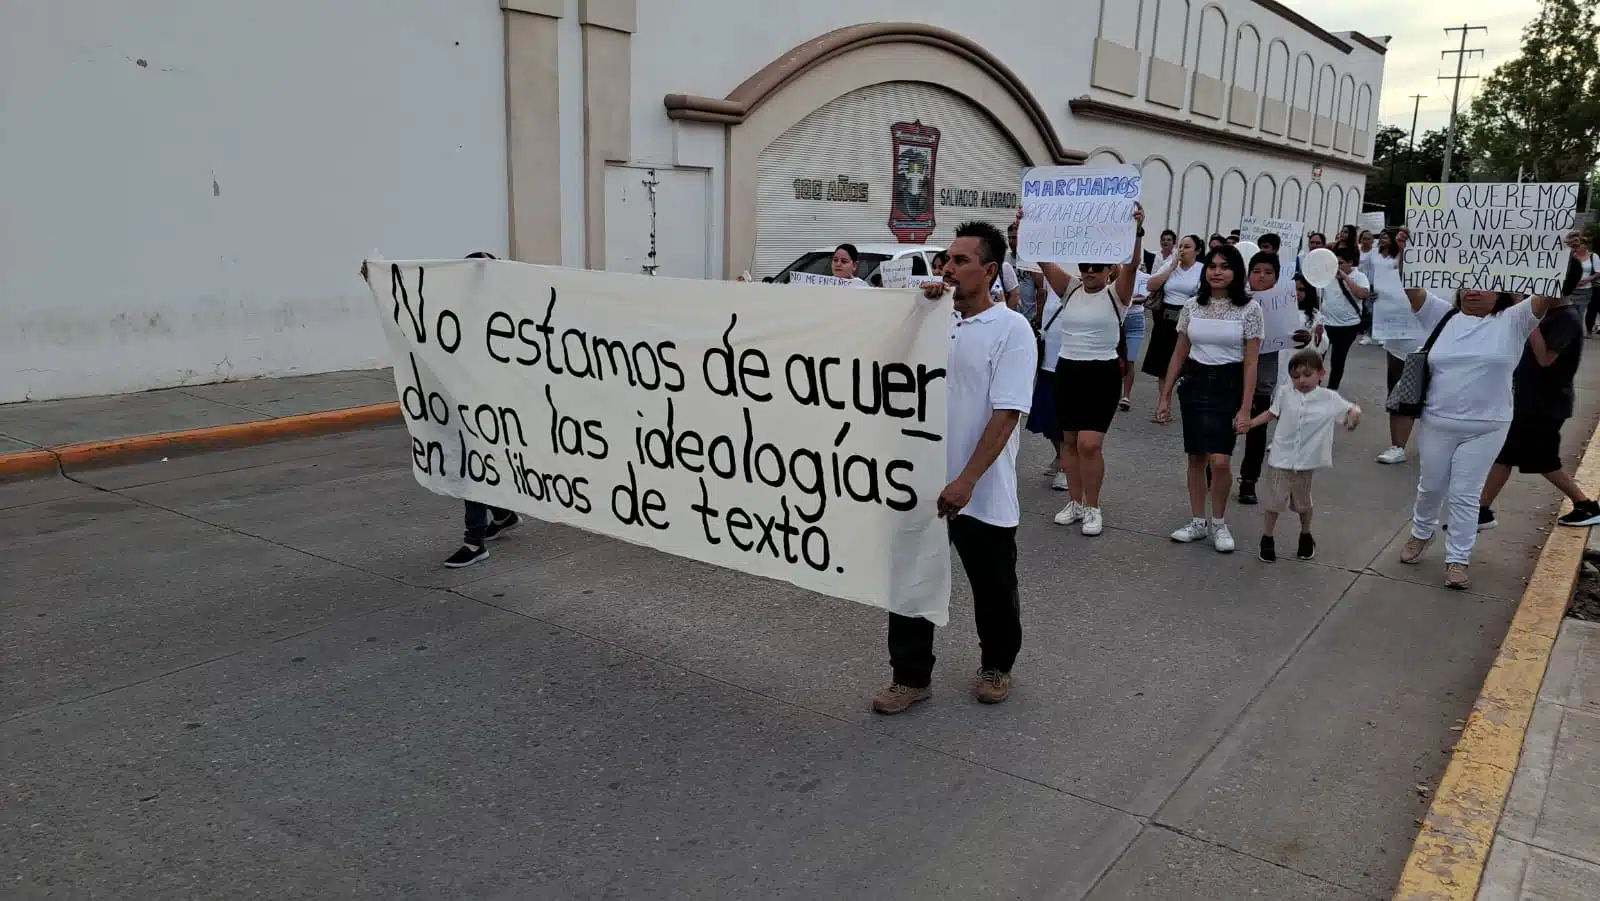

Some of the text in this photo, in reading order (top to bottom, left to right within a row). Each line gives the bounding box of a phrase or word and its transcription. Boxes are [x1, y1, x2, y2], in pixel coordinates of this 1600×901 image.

[793, 174, 869, 202] 100 AÑOS
[940, 187, 1018, 209] SALVADOR ALVARADO
[1024, 176, 1141, 198] MARCHAMOS
[1408, 184, 1578, 209] NO QUEREMOS
[1406, 208, 1459, 230] PARA
[1473, 208, 1577, 231] NUESTROS
[1055, 226, 1094, 239] LIBRE
[1470, 233, 1505, 251] UNA
[1029, 241, 1044, 255] DE
[1404, 245, 1559, 269] CIÓN BASADA EN
[1470, 264, 1491, 275] LA
[1403, 271, 1564, 298] HIPERSEXUALIZACIÓN
[391, 264, 462, 355] No
[486, 286, 686, 393] estamos
[703, 313, 774, 403] de
[403, 351, 919, 524] do con las ideologías
[414, 428, 846, 574] en los libros de texto.
